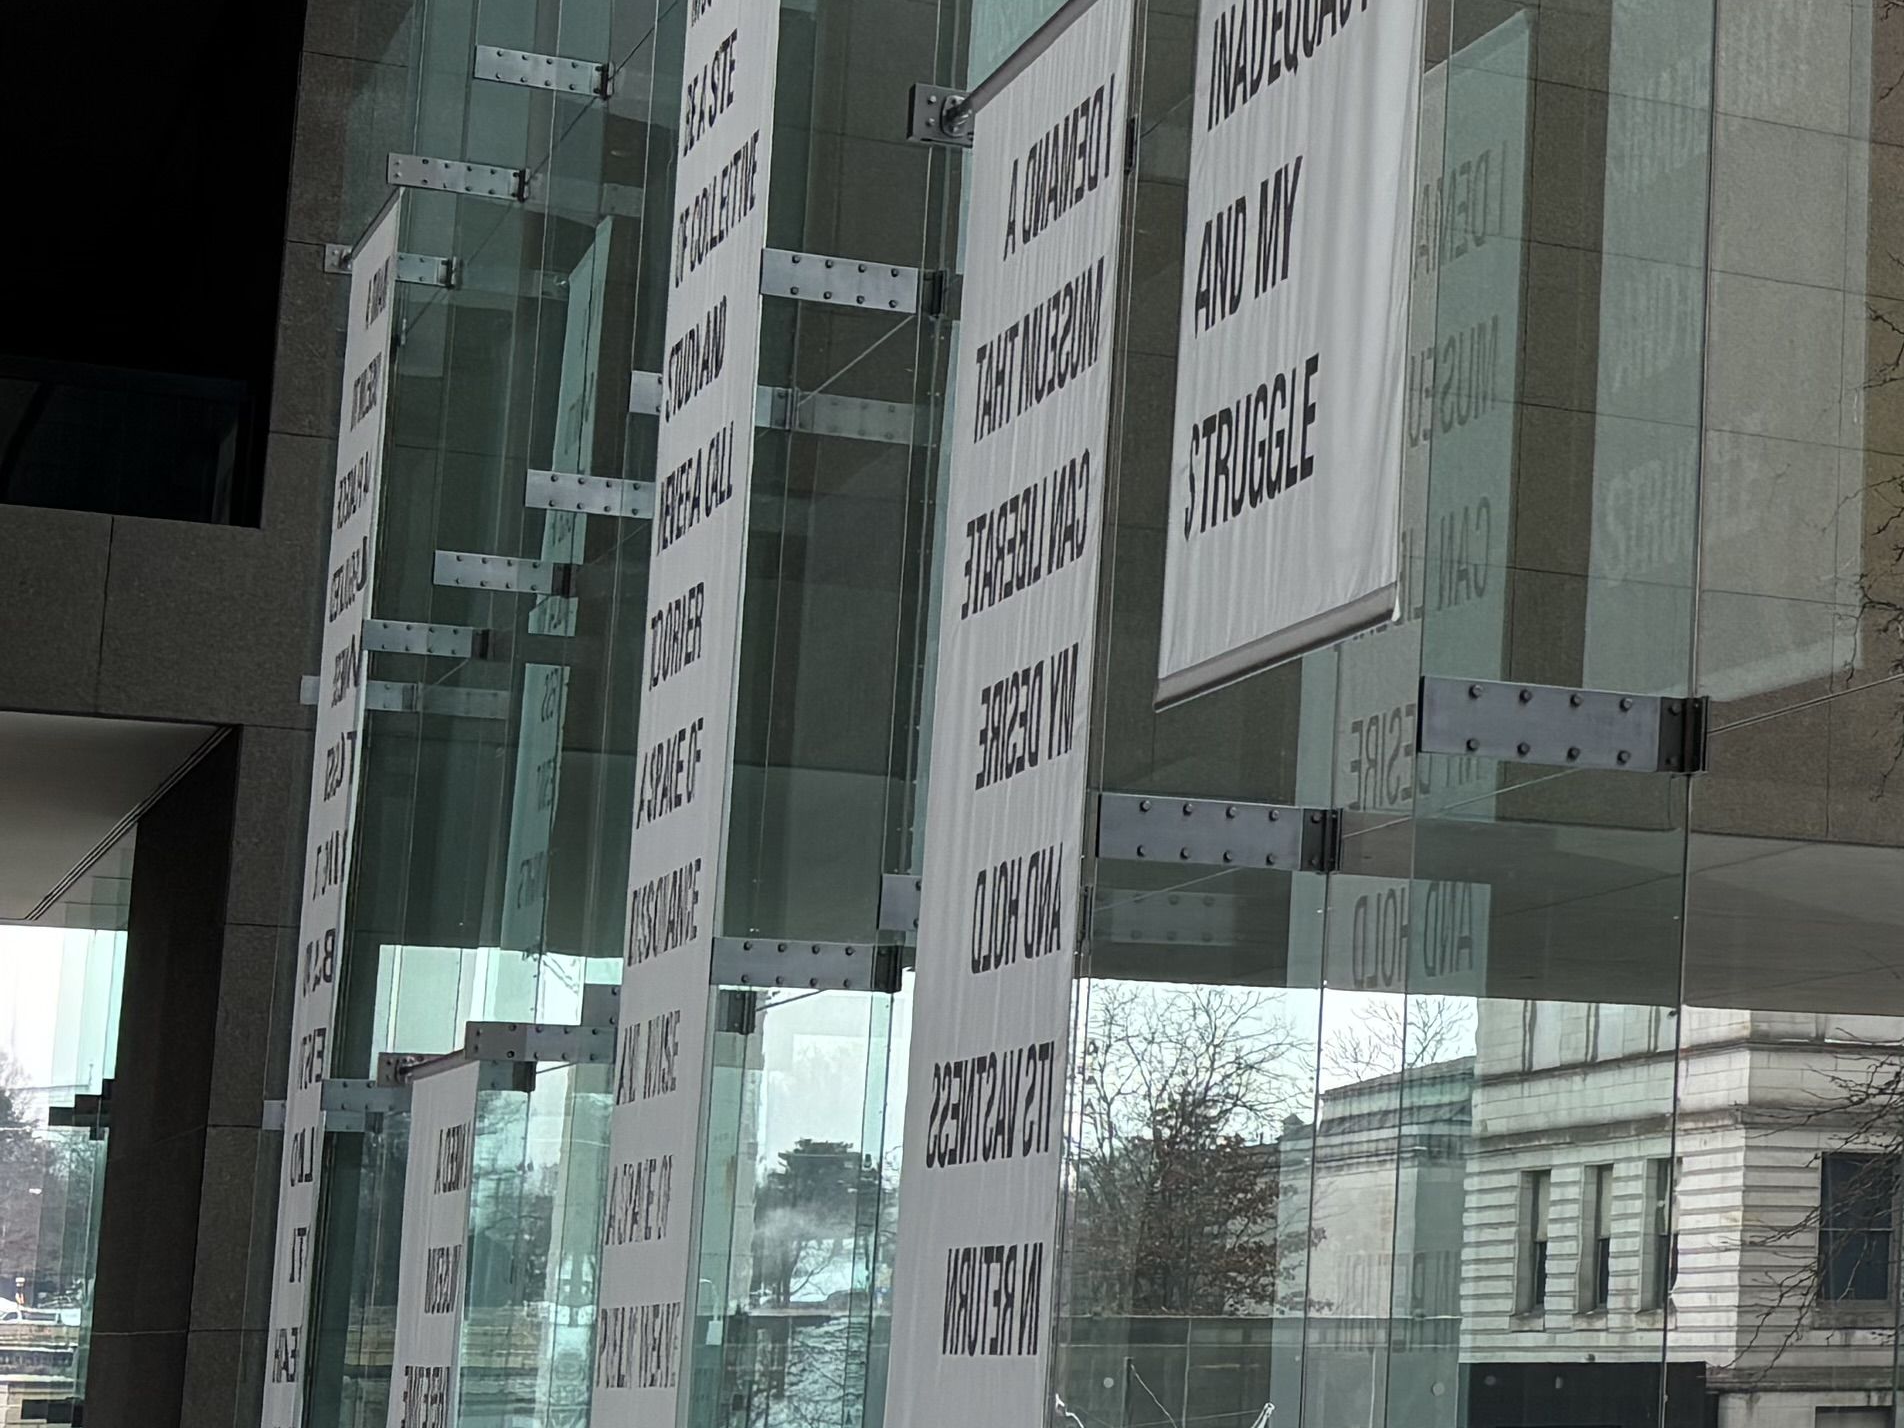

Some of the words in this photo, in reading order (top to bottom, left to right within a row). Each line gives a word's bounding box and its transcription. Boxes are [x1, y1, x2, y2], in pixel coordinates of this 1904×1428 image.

[1194, 184, 1248, 340] AND
[1253, 154, 1304, 307] MY
[1181, 352, 1320, 543] STRUGGLE
